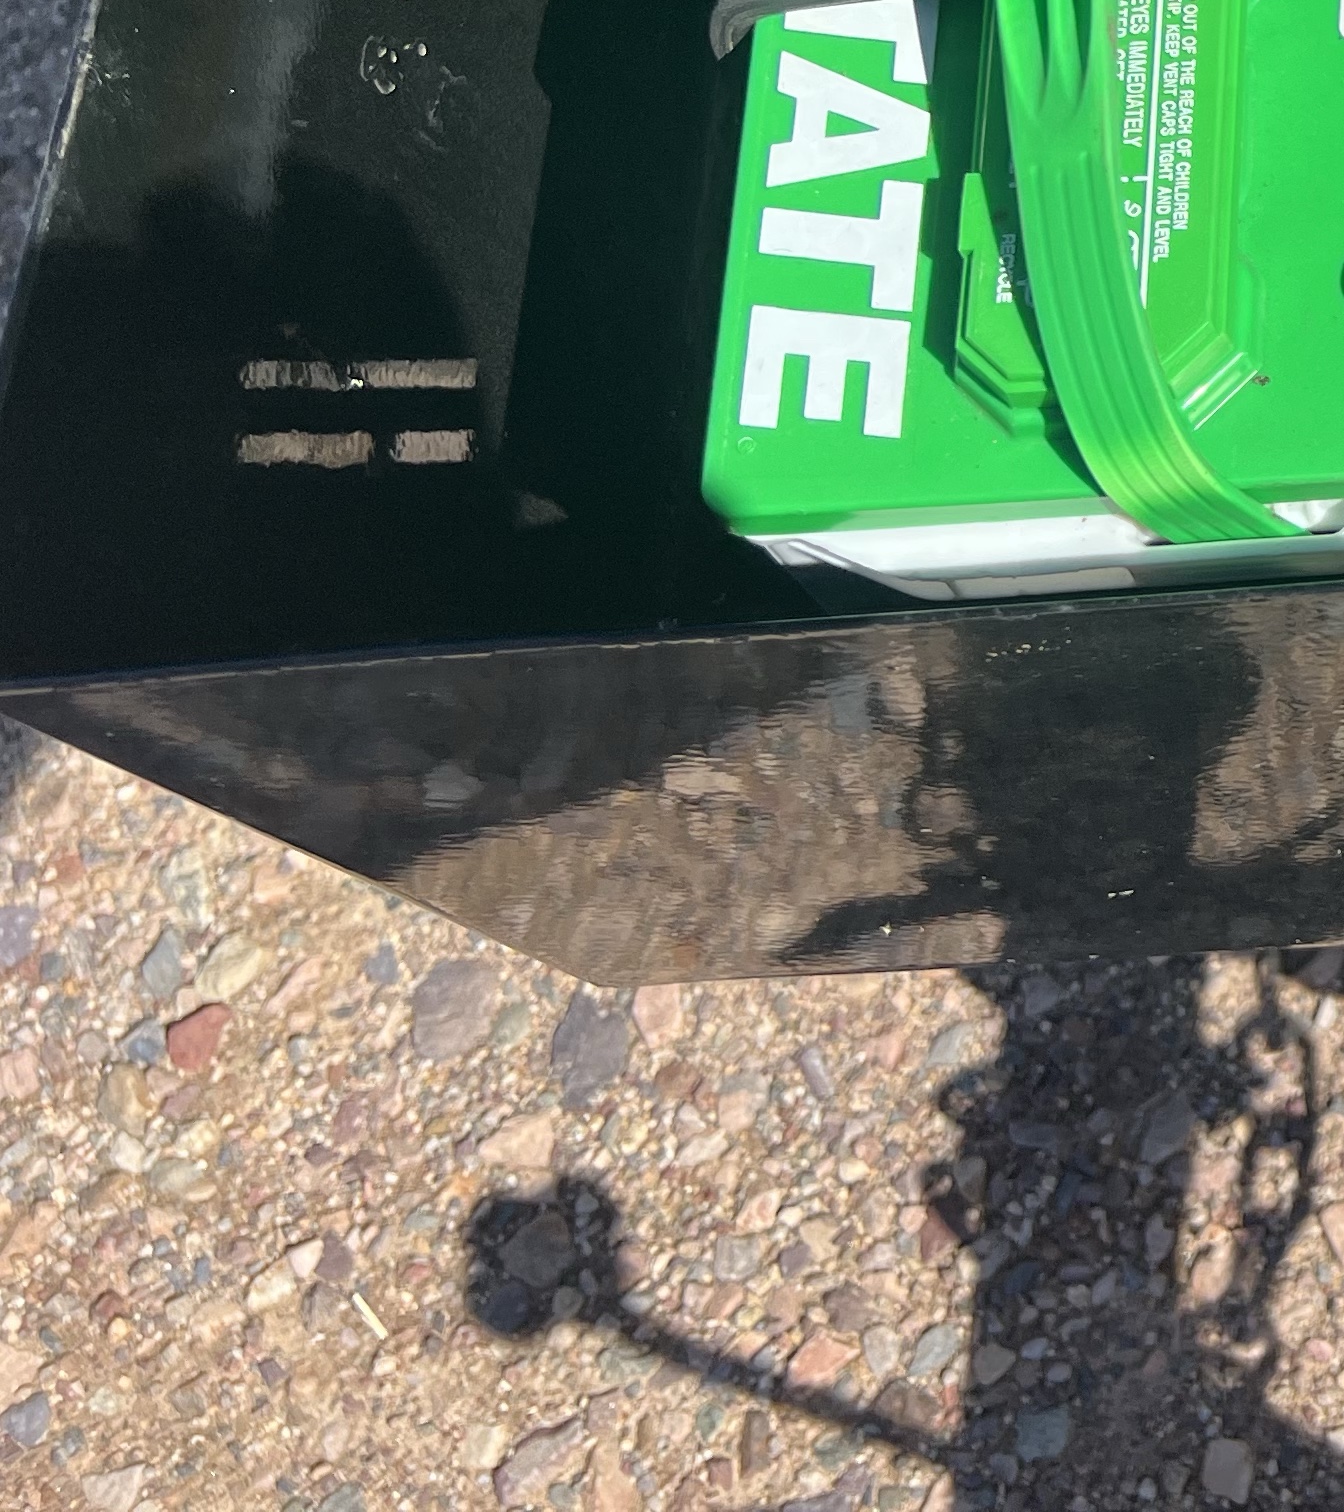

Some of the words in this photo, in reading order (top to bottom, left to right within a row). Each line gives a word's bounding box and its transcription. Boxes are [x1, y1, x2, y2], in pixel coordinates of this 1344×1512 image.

[1182, 4, 1198, 31] OUT
[1164, 23, 1180, 58] KEEP
[1181, 36, 1197, 55] OF
[1162, 62, 1179, 96] VENT
[1179, 59, 1196, 86] THE
[1122, 40, 1148, 148] IMMEDIATELY
[1177, 89, 1194, 135] REACH
[1159, 100, 1177, 137] CAPS
[1157, 141, 1174, 181] TIGHT
[1176, 138, 1192, 158] OF
[1155, 185, 1171, 216] AND
[1172, 161, 1191, 230] CHILDREN
[1152, 219, 1169, 263] LEVEL
[995, 233, 1017, 304] RECYCLE
